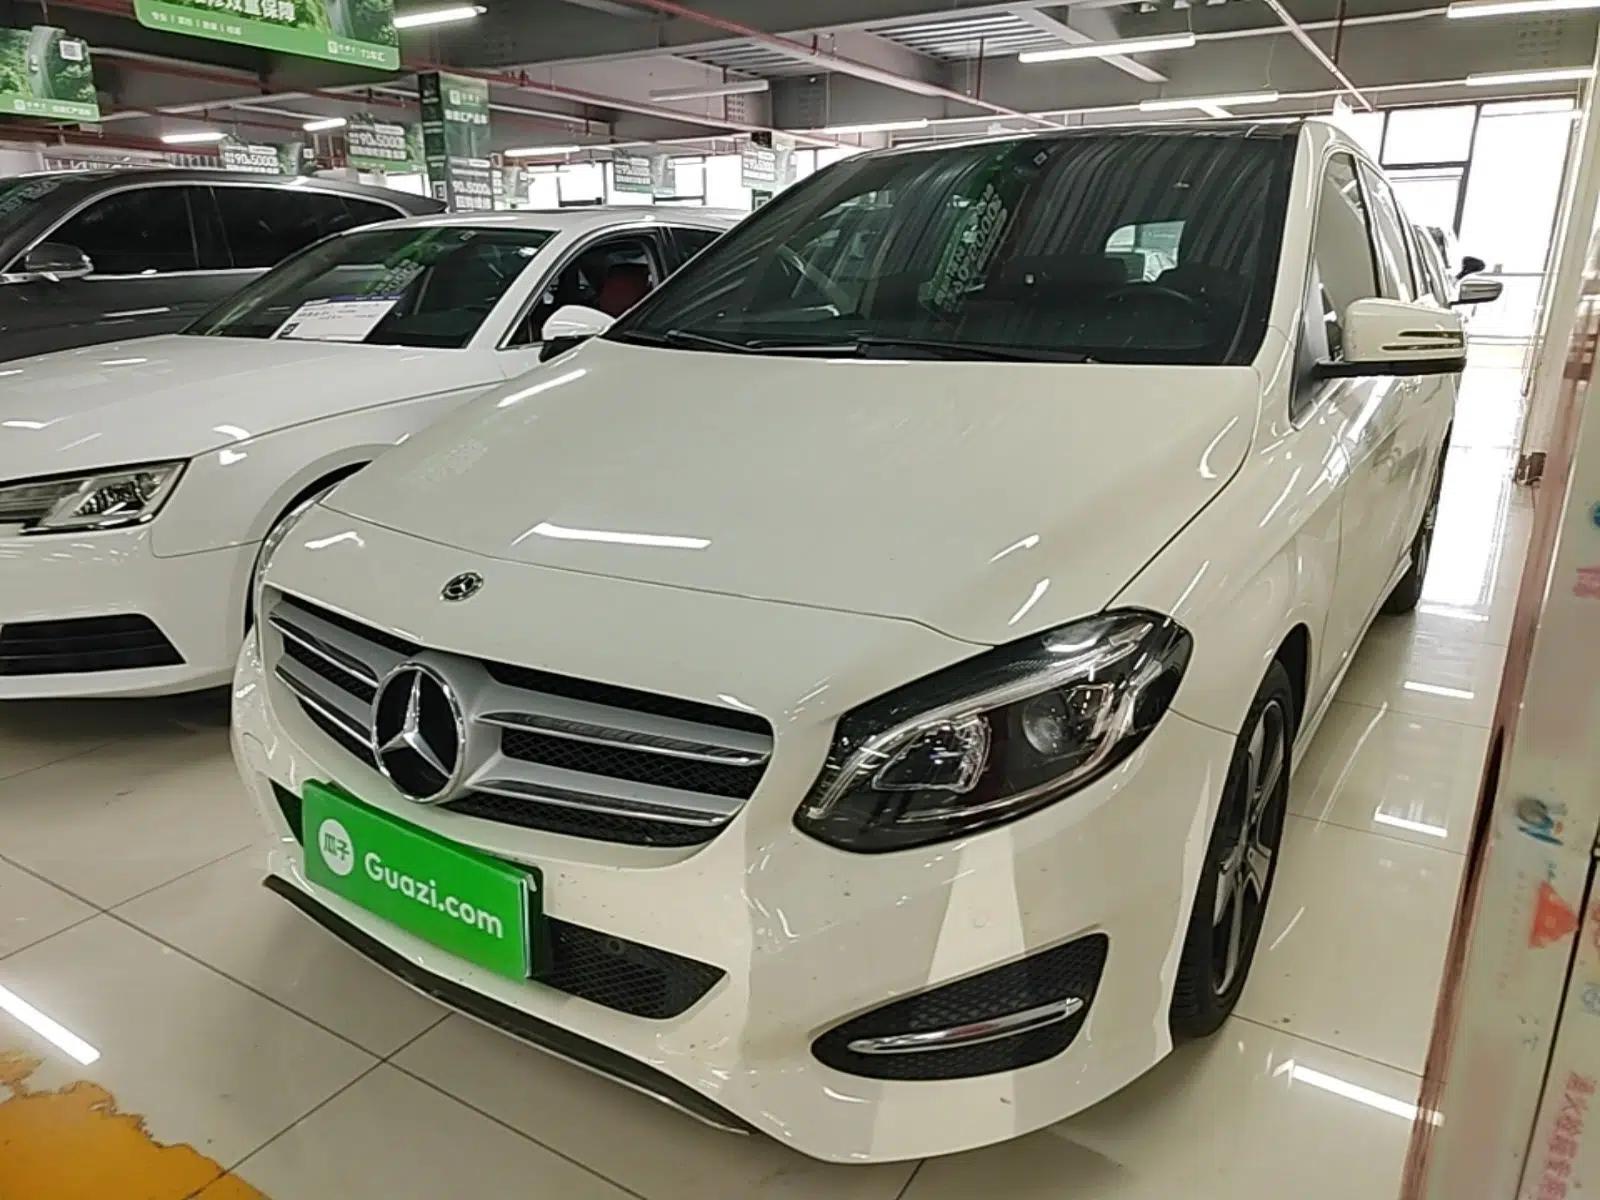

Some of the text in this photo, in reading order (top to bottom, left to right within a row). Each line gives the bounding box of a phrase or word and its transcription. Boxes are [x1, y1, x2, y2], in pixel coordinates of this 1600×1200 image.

[195, 0, 294, 22] 双重保障
[323, 832, 351, 862] 瓜子
[364, 852, 504, 939] Guazi.com
